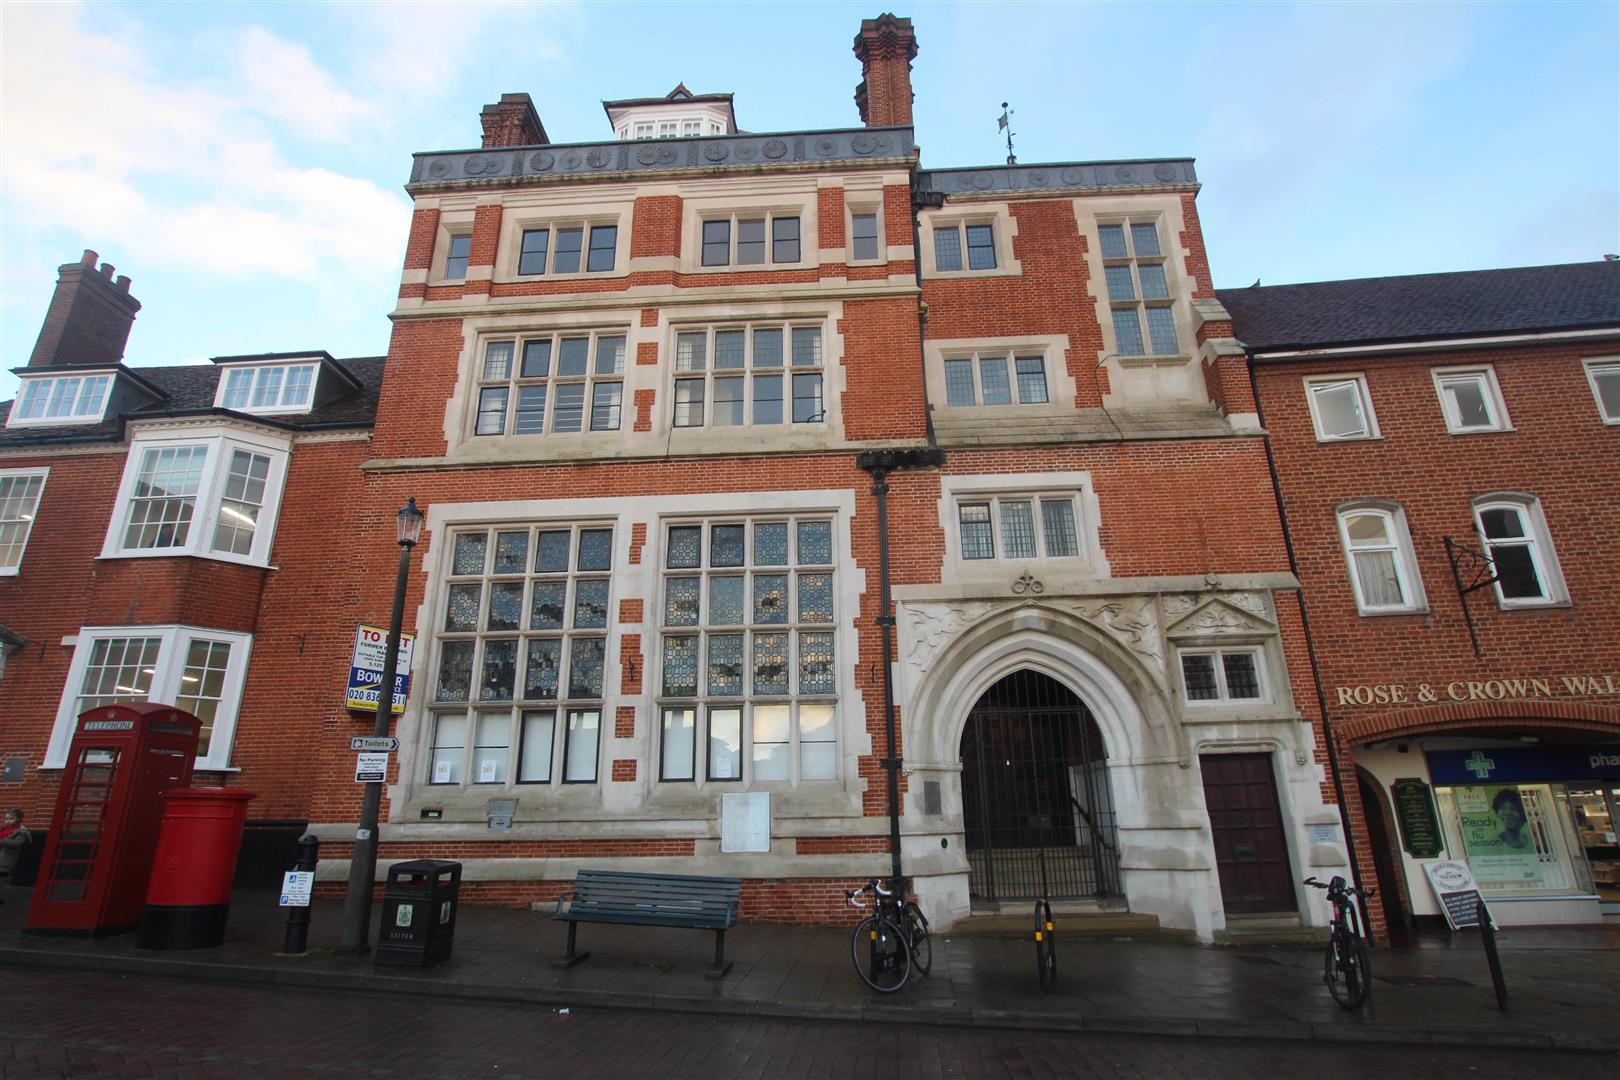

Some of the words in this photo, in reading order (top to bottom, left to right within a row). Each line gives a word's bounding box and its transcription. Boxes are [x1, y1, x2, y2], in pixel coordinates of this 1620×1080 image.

[362, 629, 381, 642] TO
[357, 669, 403, 686] BOWR
[349, 688, 364, 700] 020
[1336, 683, 1408, 706] ROSE
[1418, 682, 1438, 703] &
[1447, 677, 1552, 702] CROWN
[87, 721, 133, 730] TELEPHONE
[1461, 816, 1498, 829] Ready
[1471, 830, 1485, 840] flu
